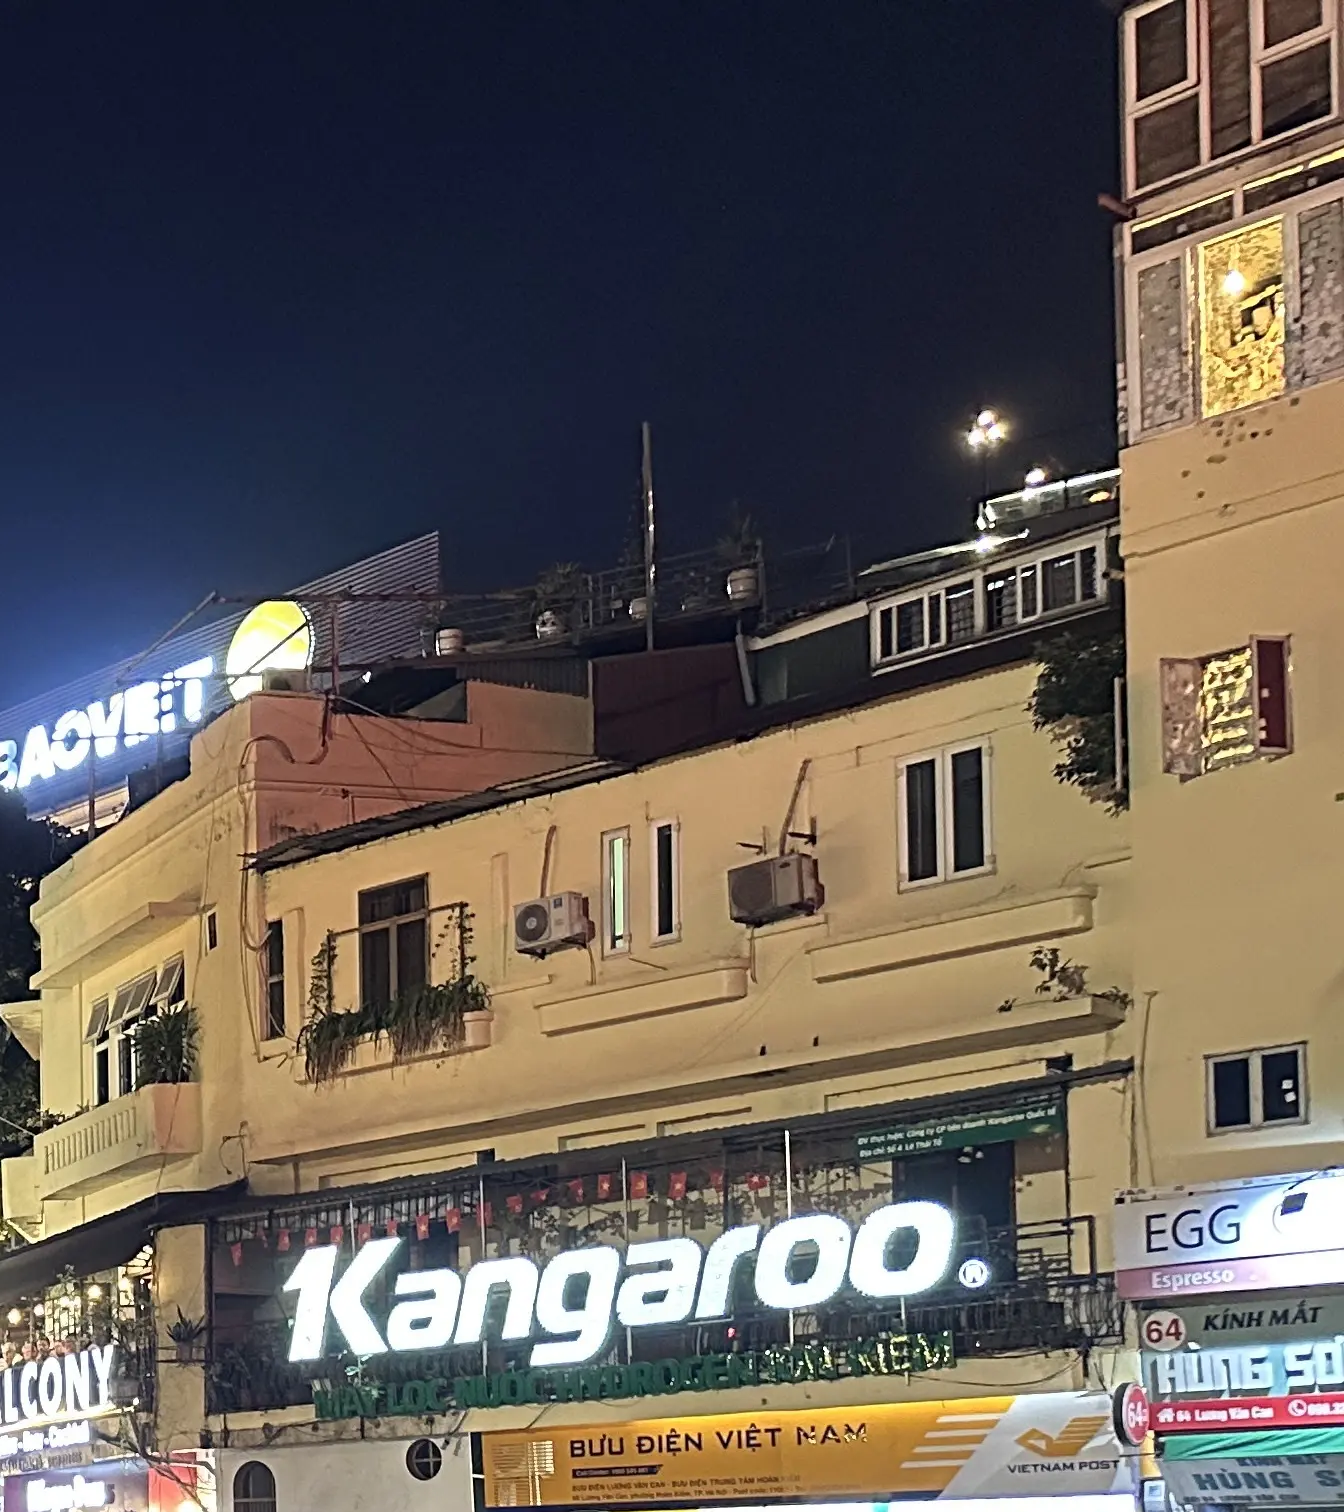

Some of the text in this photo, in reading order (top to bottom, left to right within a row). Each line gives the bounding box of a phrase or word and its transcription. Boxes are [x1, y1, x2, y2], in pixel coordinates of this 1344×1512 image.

[1146, 1204, 1241, 1253] EGG
[283, 1200, 955, 1366] Kangaroo
[1151, 1269, 1235, 1291] Espresso
[1203, 1300, 1323, 1331] KÍNH MẮT
[1146, 1318, 1182, 1343] 64
[570, 1423, 868, 1457] BƯU ĐIỆN VIỆT NAM
[1008, 1460, 1120, 1474] VIETNAM POST
[1192, 1468, 1294, 1491] HÙNG
